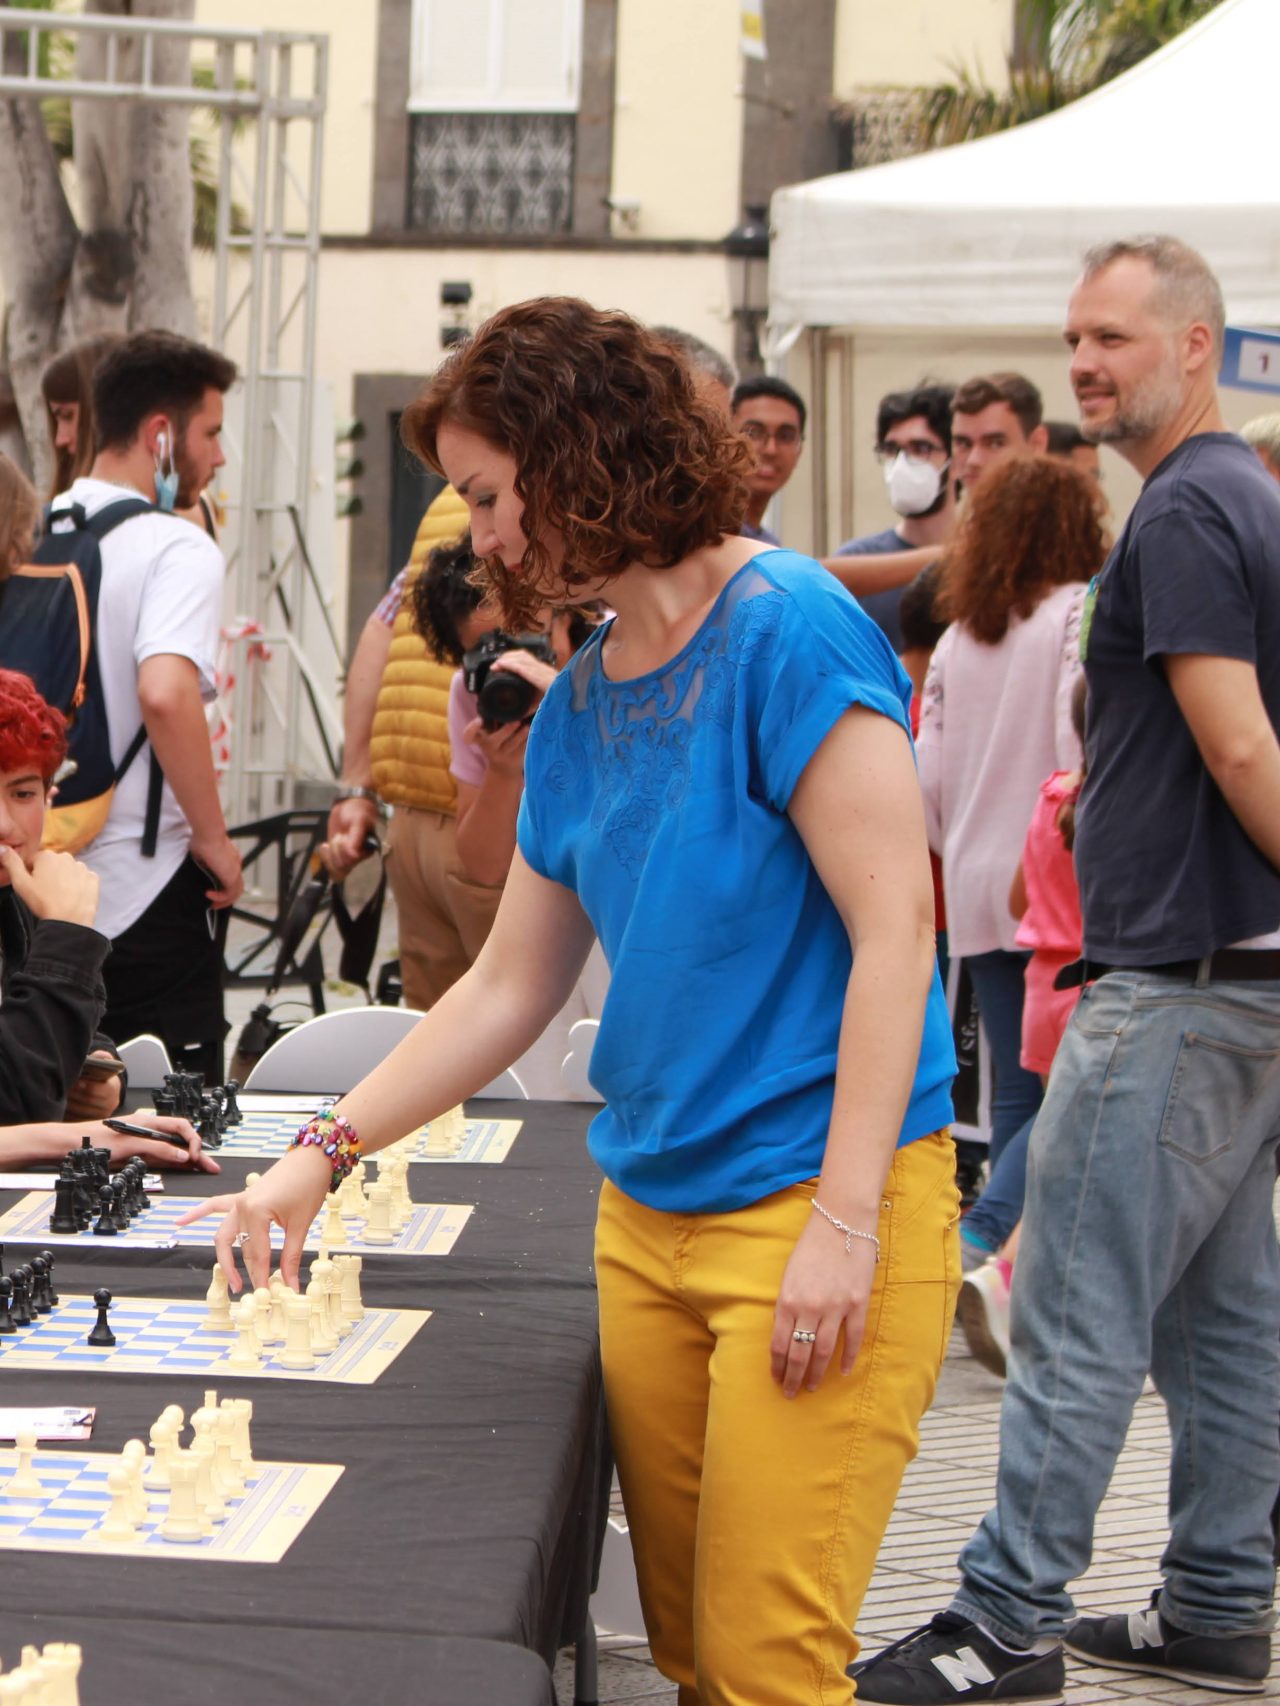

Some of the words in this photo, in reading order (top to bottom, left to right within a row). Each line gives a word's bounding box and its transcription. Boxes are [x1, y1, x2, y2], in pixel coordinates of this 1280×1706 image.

[1259, 353, 1269, 374] 1
[1127, 1611, 1165, 1650] N
[930, 1646, 996, 1693] N
